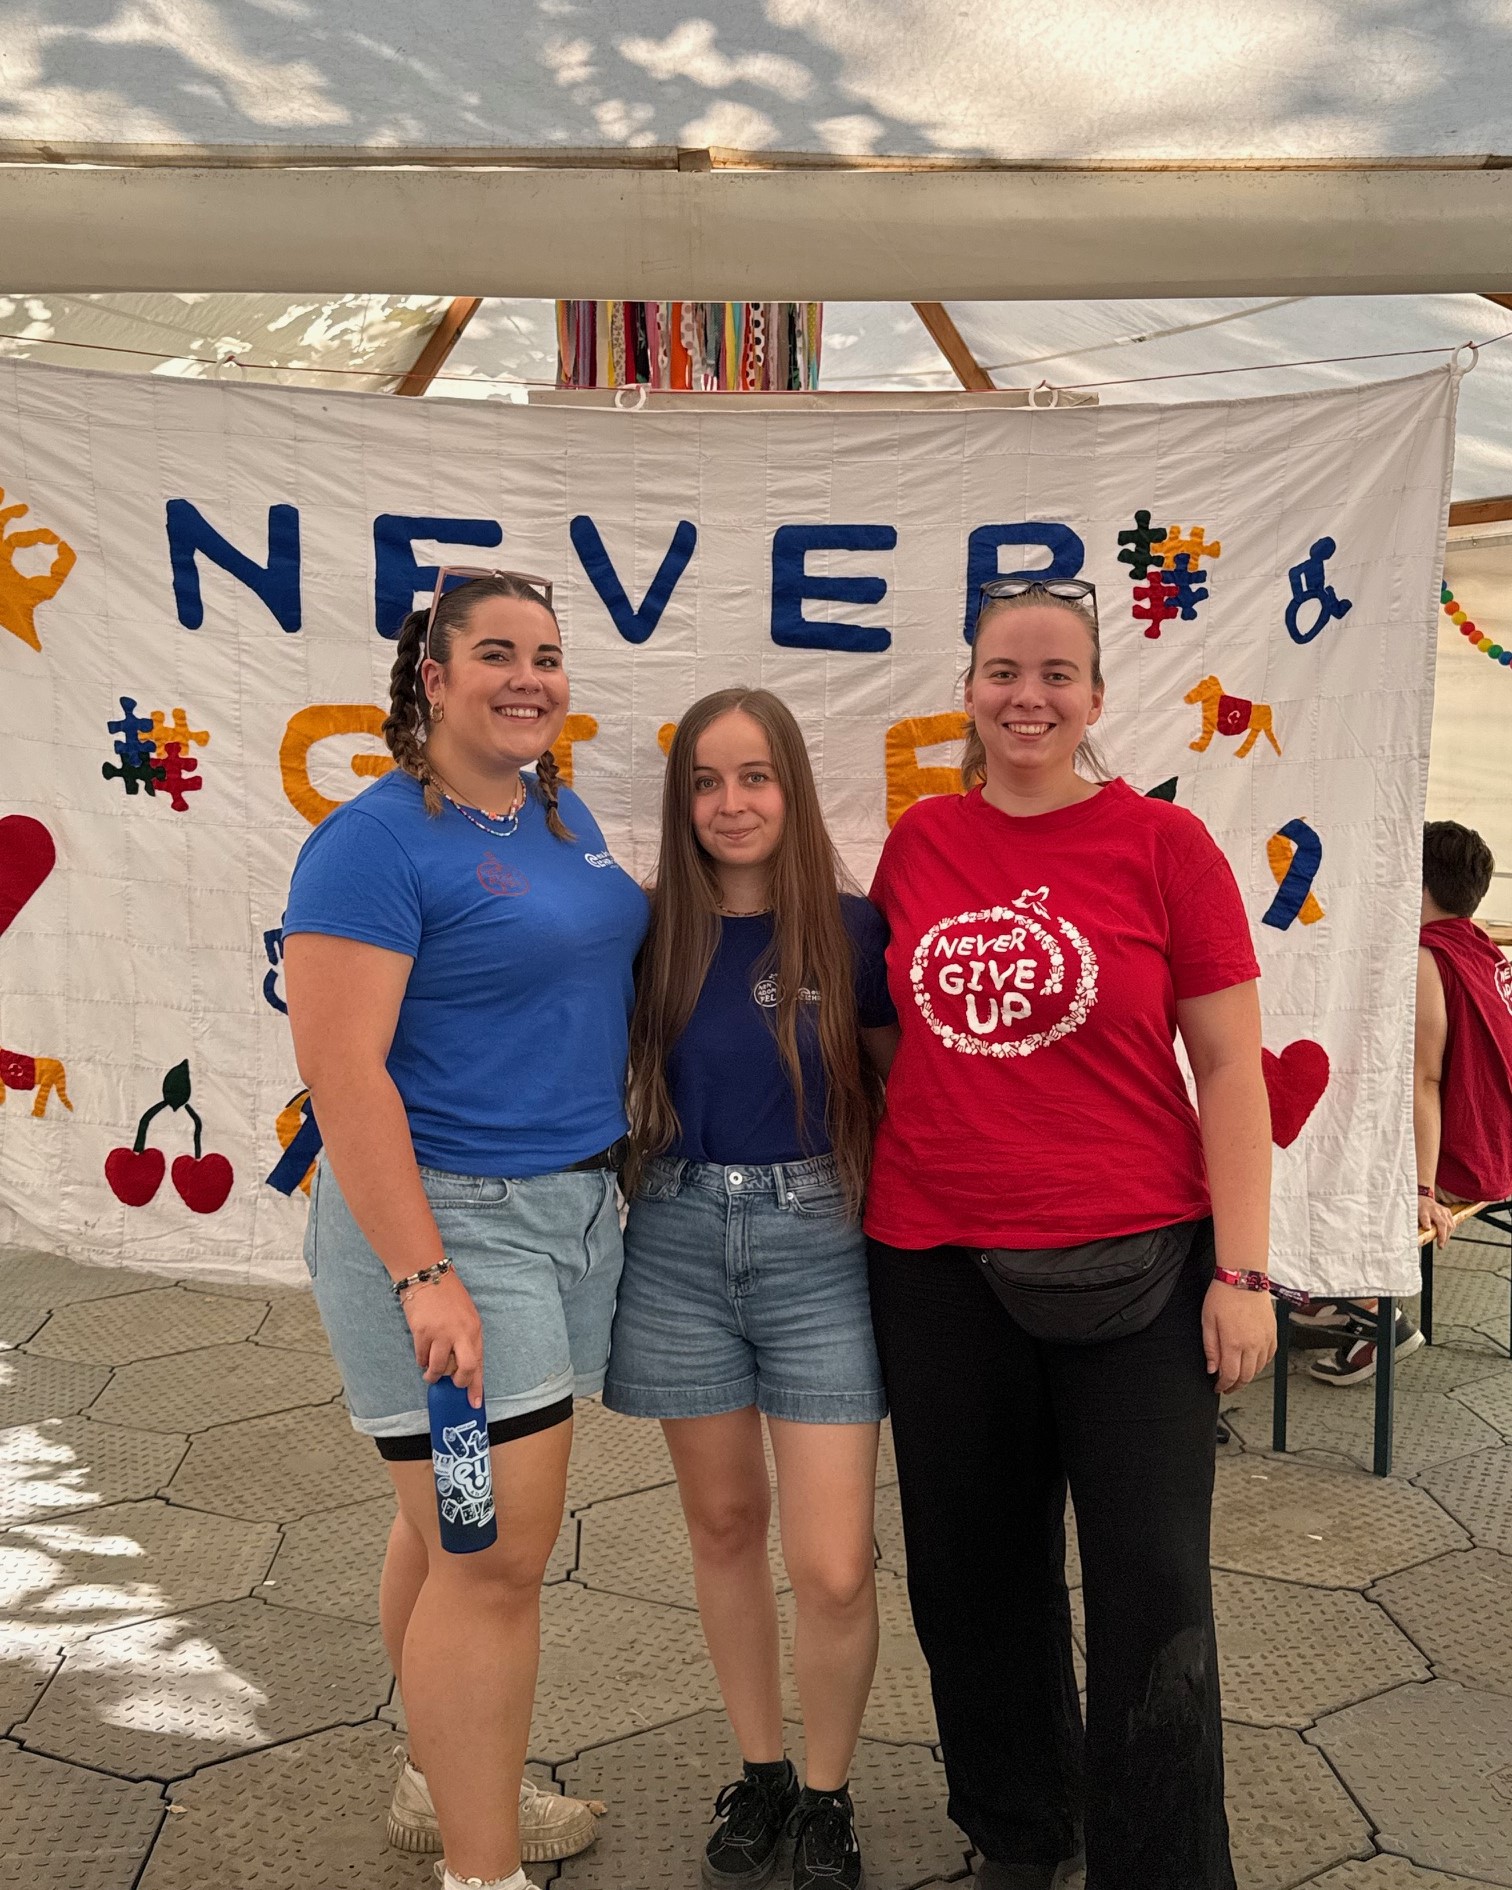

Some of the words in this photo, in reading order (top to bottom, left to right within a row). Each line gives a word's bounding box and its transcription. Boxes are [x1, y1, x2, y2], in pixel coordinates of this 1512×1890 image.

[166, 498, 1085, 652] NEVER
[279, 704, 987, 831] GE
[934, 927, 1027, 959] NEVER
[938, 959, 1038, 995] GIVE
[965, 992, 1032, 1035] UP
